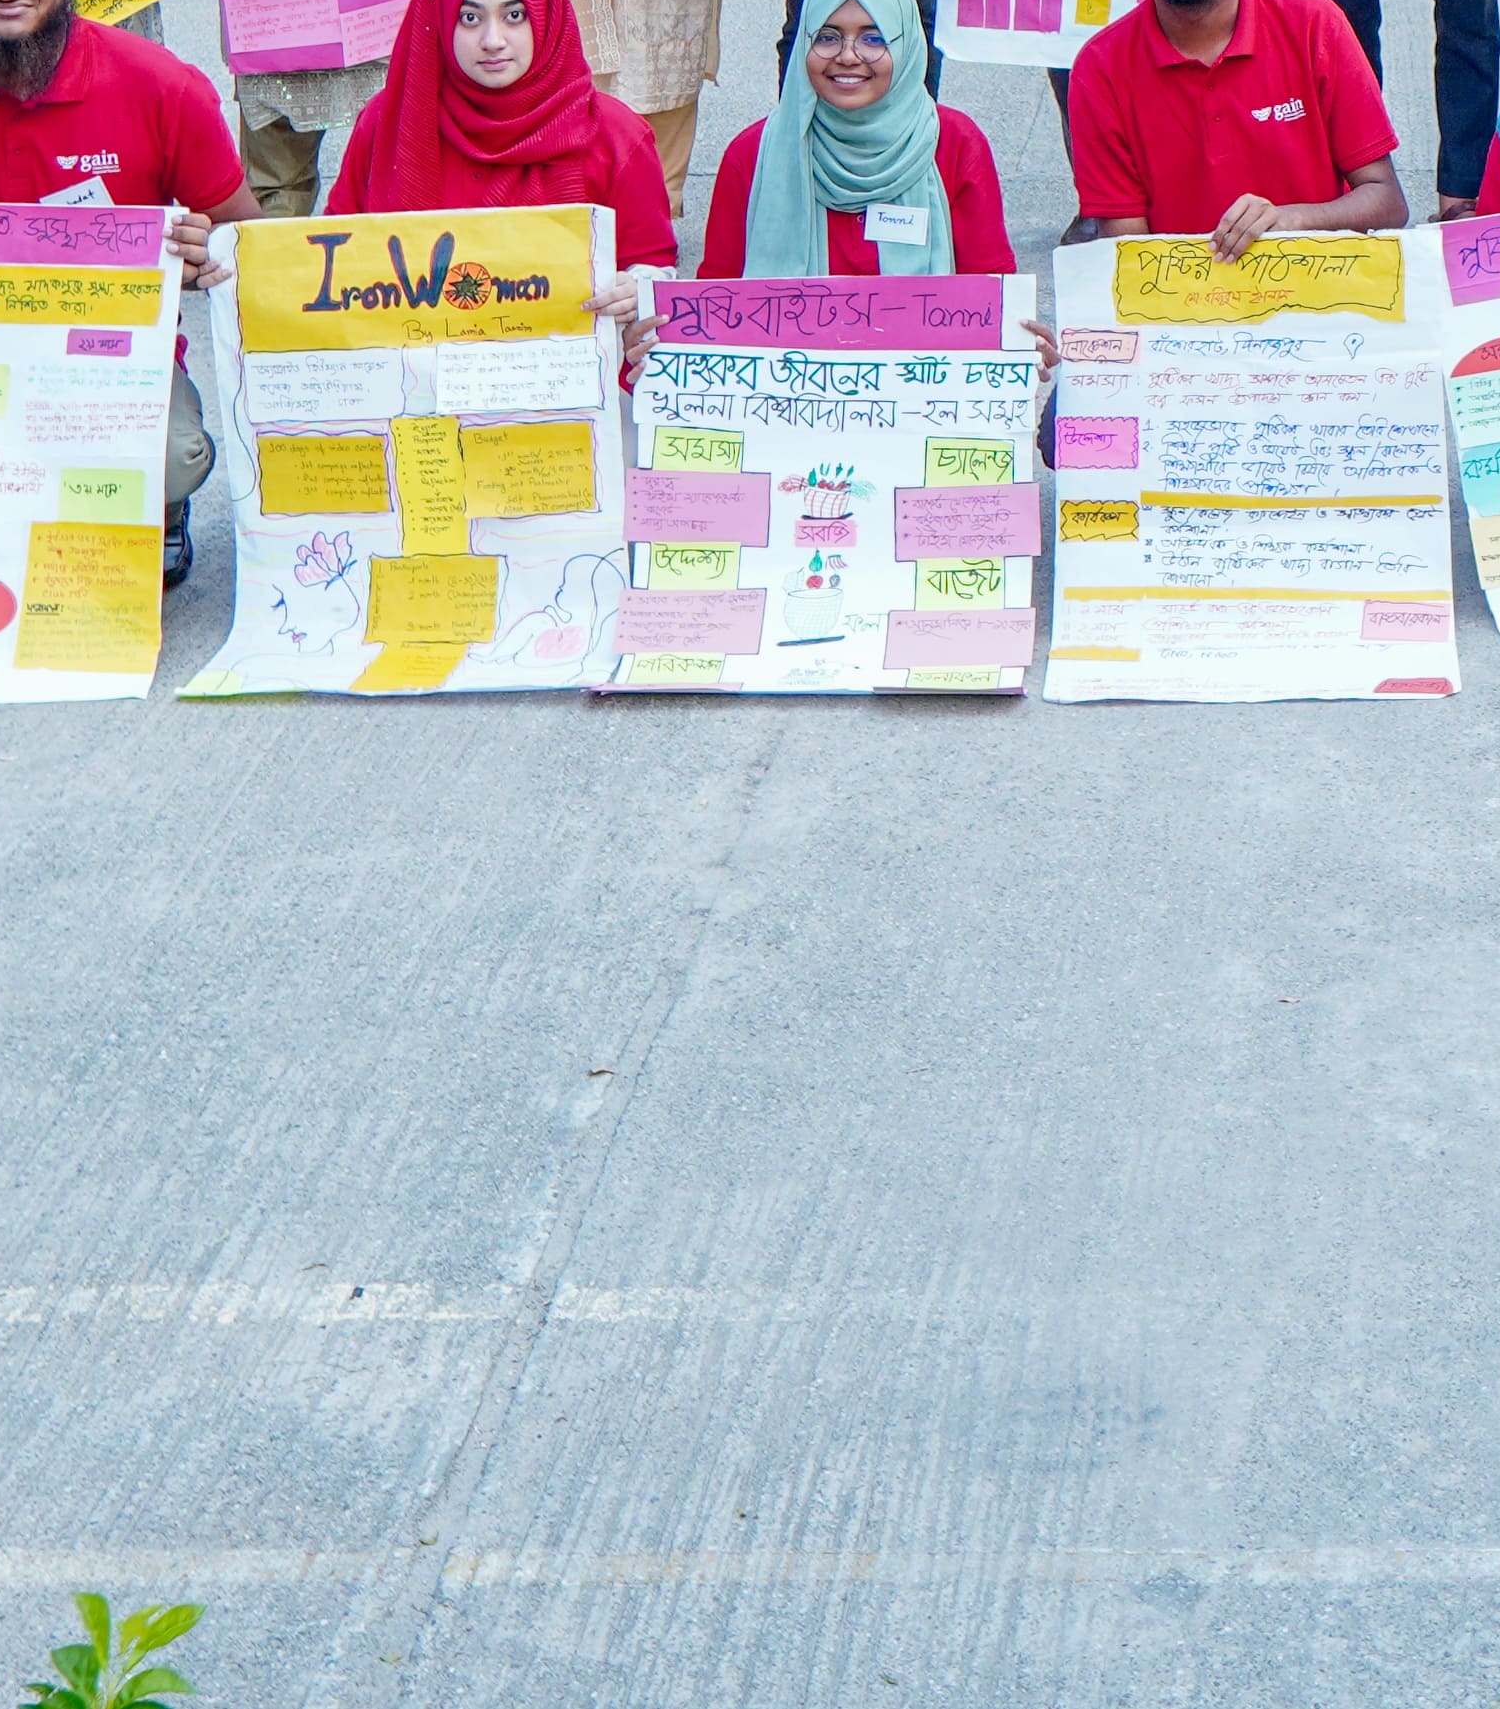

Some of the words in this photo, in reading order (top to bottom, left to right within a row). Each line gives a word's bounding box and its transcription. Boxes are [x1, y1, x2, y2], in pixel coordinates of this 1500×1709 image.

[1274, 98, 1304, 120] gain
[80, 150, 119, 172] gain
[402, 318, 434, 344] By
